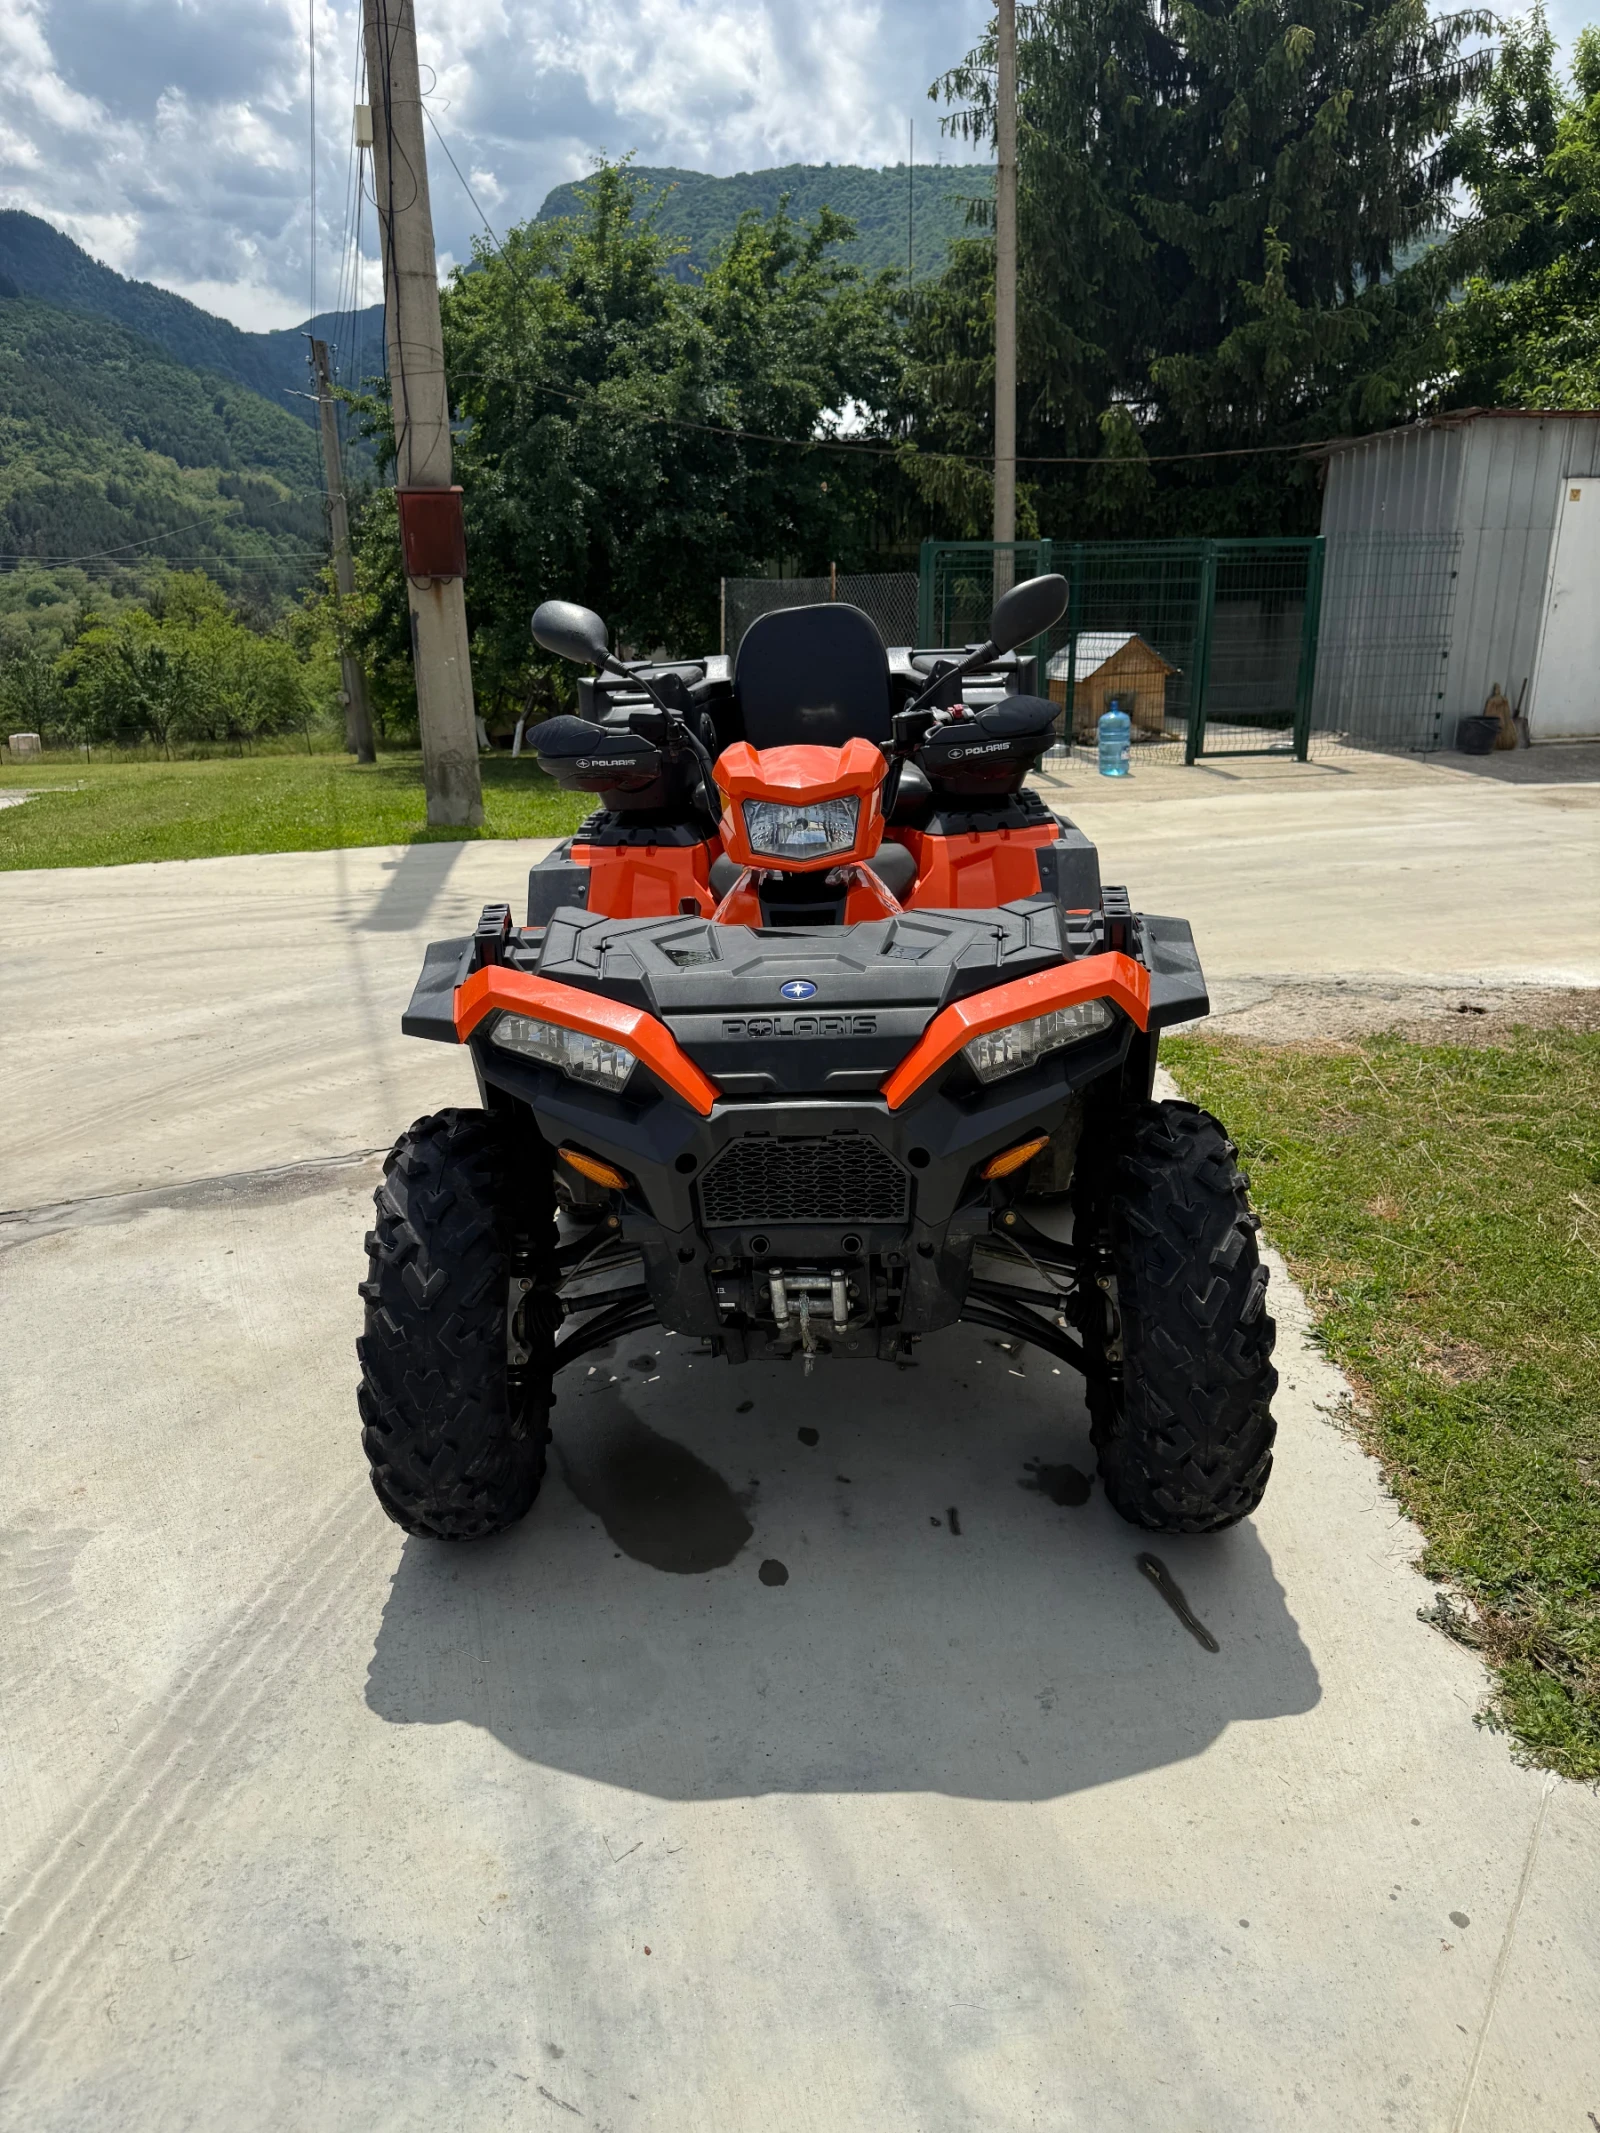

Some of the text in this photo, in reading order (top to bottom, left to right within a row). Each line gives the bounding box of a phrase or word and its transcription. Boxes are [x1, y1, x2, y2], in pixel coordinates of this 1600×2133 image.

[965, 742, 1011, 756] POLARIS
[591, 759, 637, 767] POLARIS
[721, 1015, 878, 1039] POLARIS
